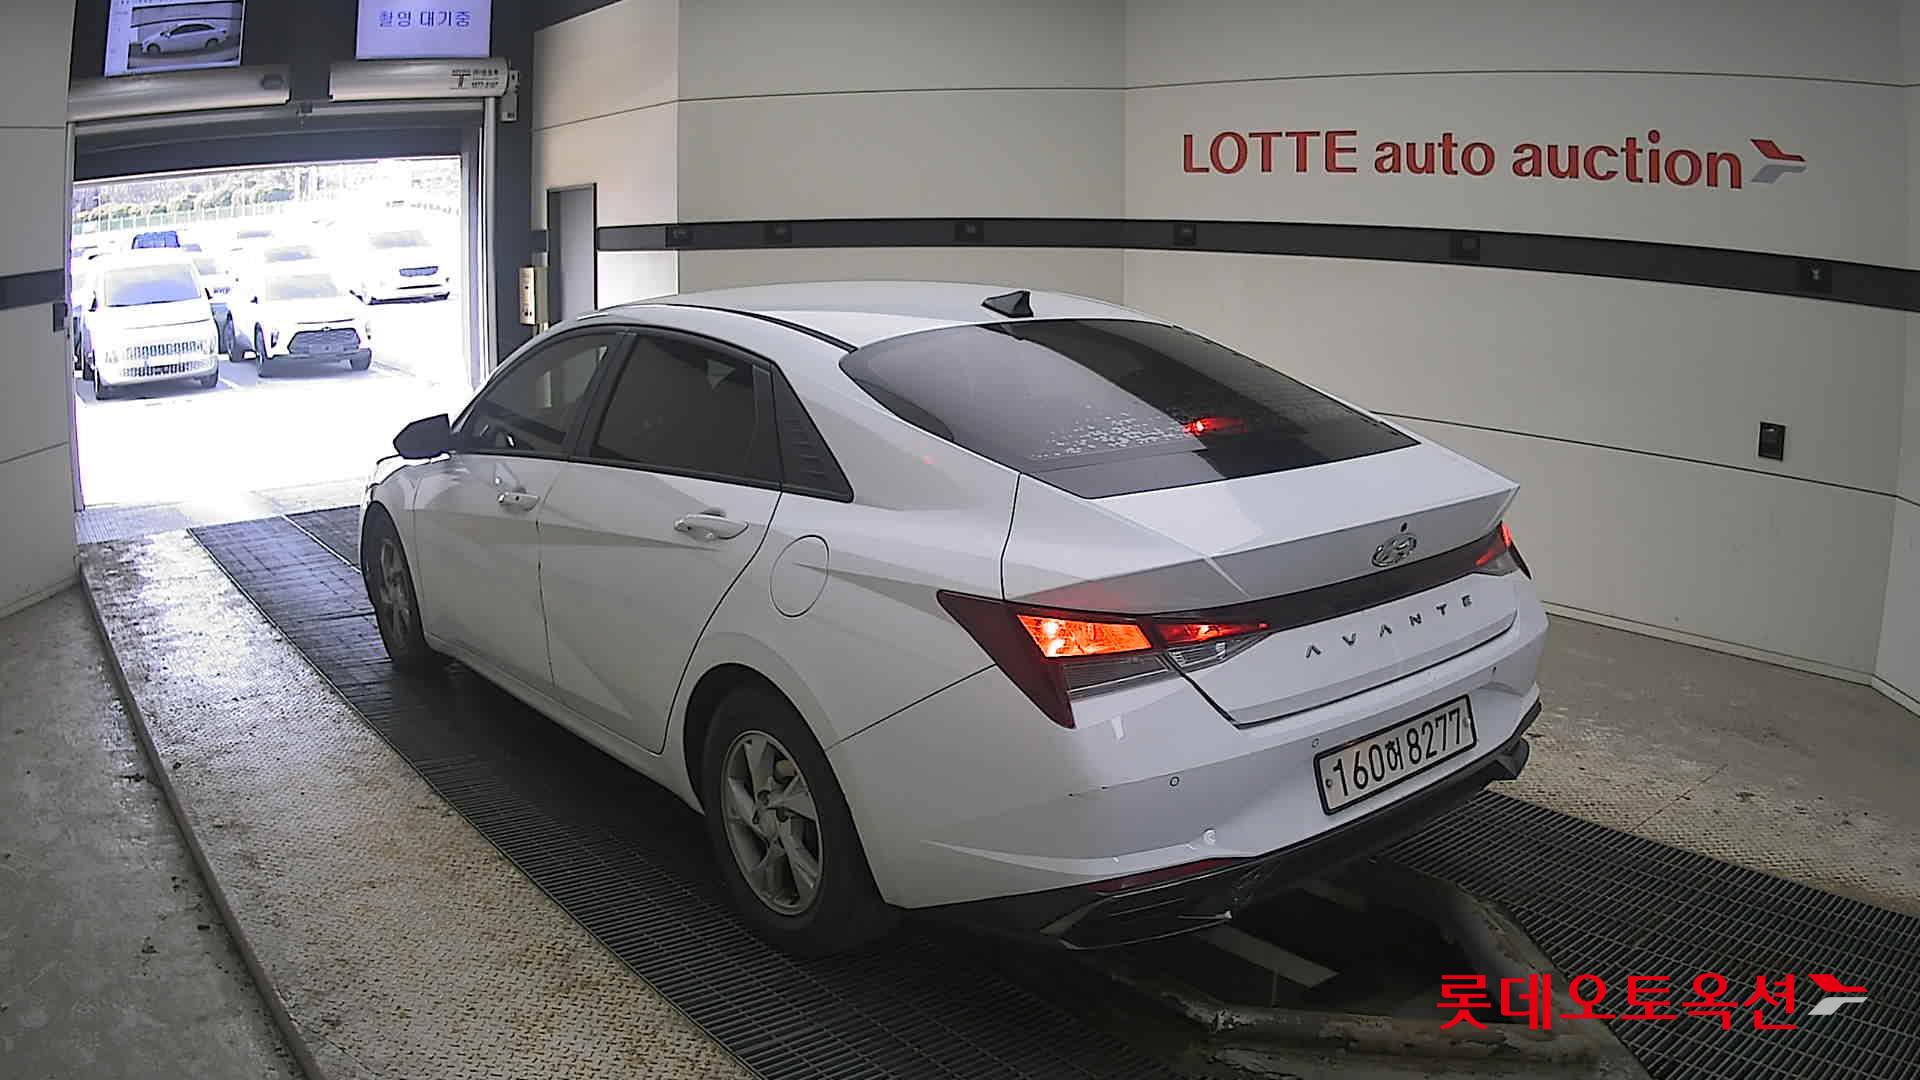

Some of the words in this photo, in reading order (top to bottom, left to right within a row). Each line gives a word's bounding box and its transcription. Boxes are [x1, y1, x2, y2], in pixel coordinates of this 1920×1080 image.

[419, 10, 471, 30] 대기중
[1183, 131, 1358, 173] LOTTE
[1376, 134, 1495, 177] auto
[1513, 130, 1742, 189] auction
[1304, 593, 1474, 660] AVANTE
[1332, 707, 1463, 797] 160허8277
